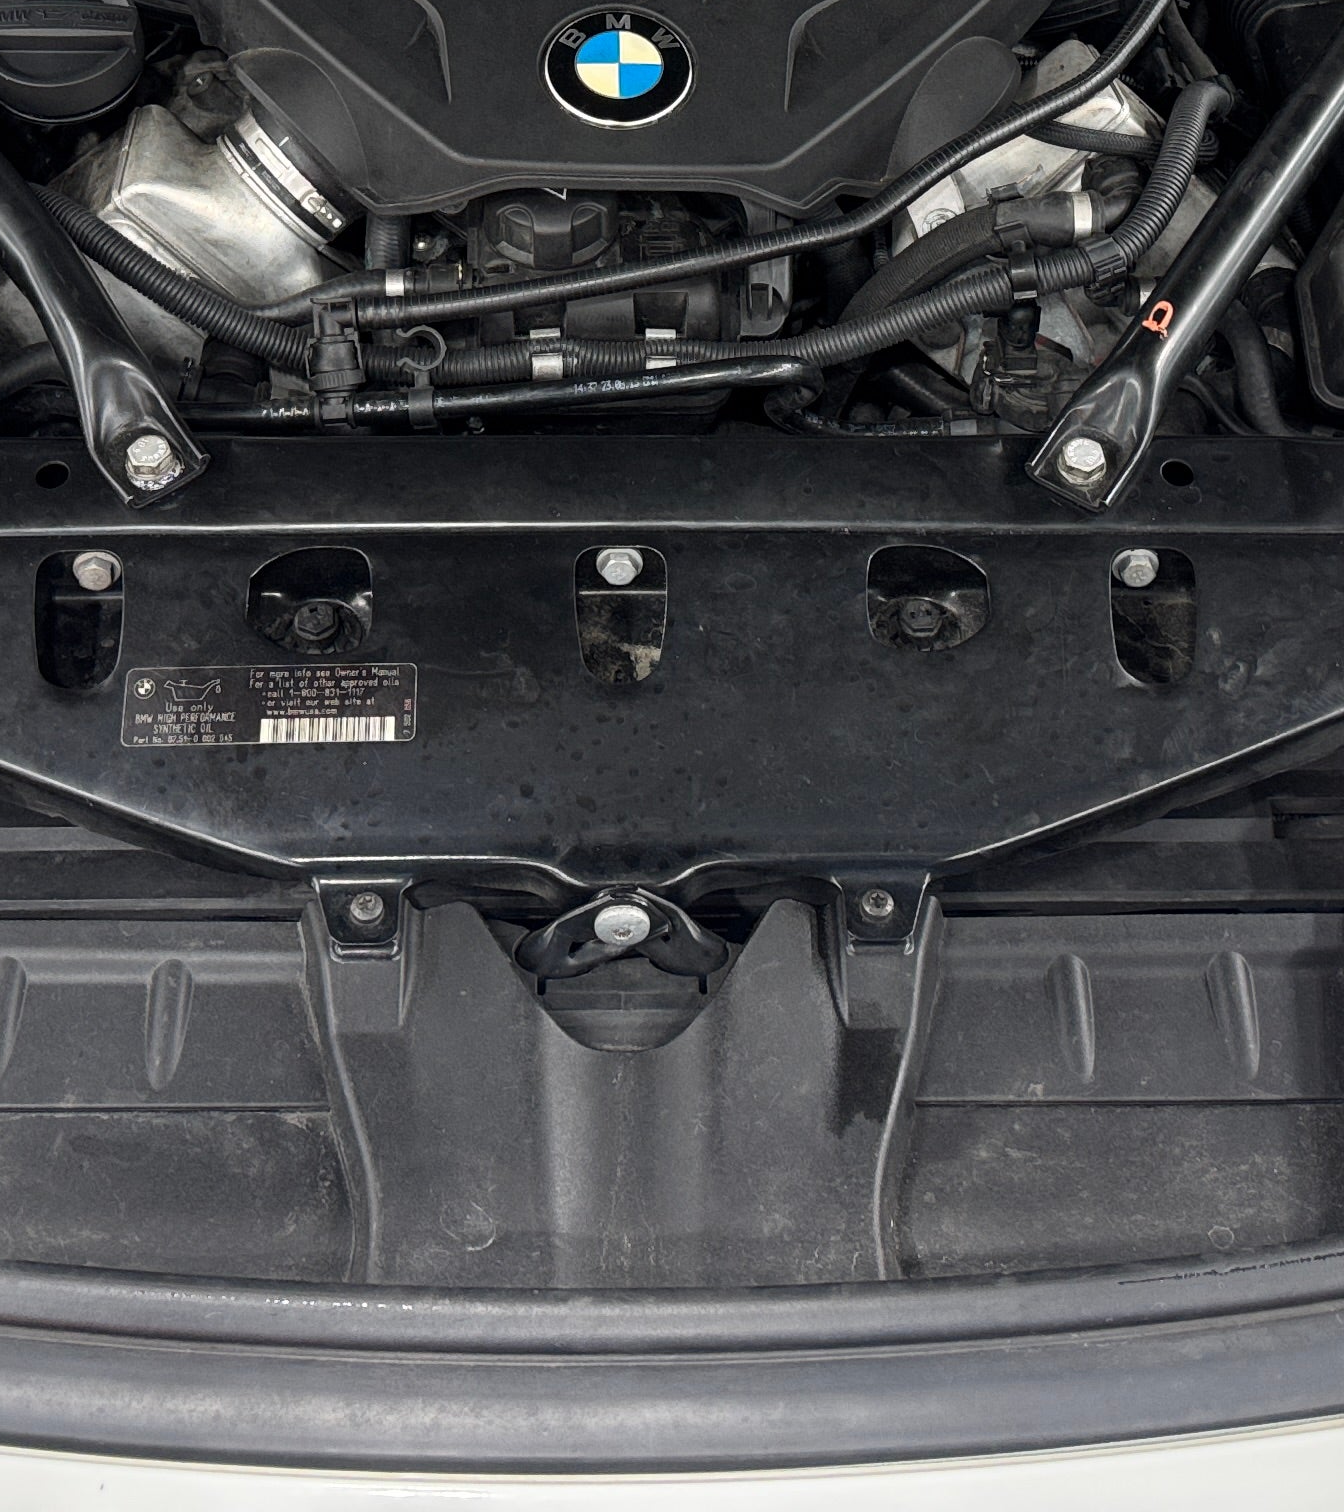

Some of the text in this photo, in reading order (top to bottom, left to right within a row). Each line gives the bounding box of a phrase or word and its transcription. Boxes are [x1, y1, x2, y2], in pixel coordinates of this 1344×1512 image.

[559, 14, 681, 49] BMW
[249, 670, 264, 678] For
[294, 668, 311, 677] info
[335, 668, 366, 677] Owner's
[371, 667, 400, 677] Manual
[249, 680, 264, 689] For
[278, 679, 294, 688] list
[299, 679, 308, 687] of
[313, 679, 336, 687] other
[340, 678, 378, 688] approved
[382, 678, 400, 686] oils
[267, 689, 284, 698] call
[165, 701, 213, 713] Use only
[281, 698, 301, 706] visit
[324, 698, 340, 706] web
[344, 697, 361, 705] site
[366, 697, 375, 705] at
[135, 712, 236, 724] BMW HIGH PERFORMANCE
[153, 724, 213, 734] SYNTHETIC OIL
[133, 736, 148, 744] Part
